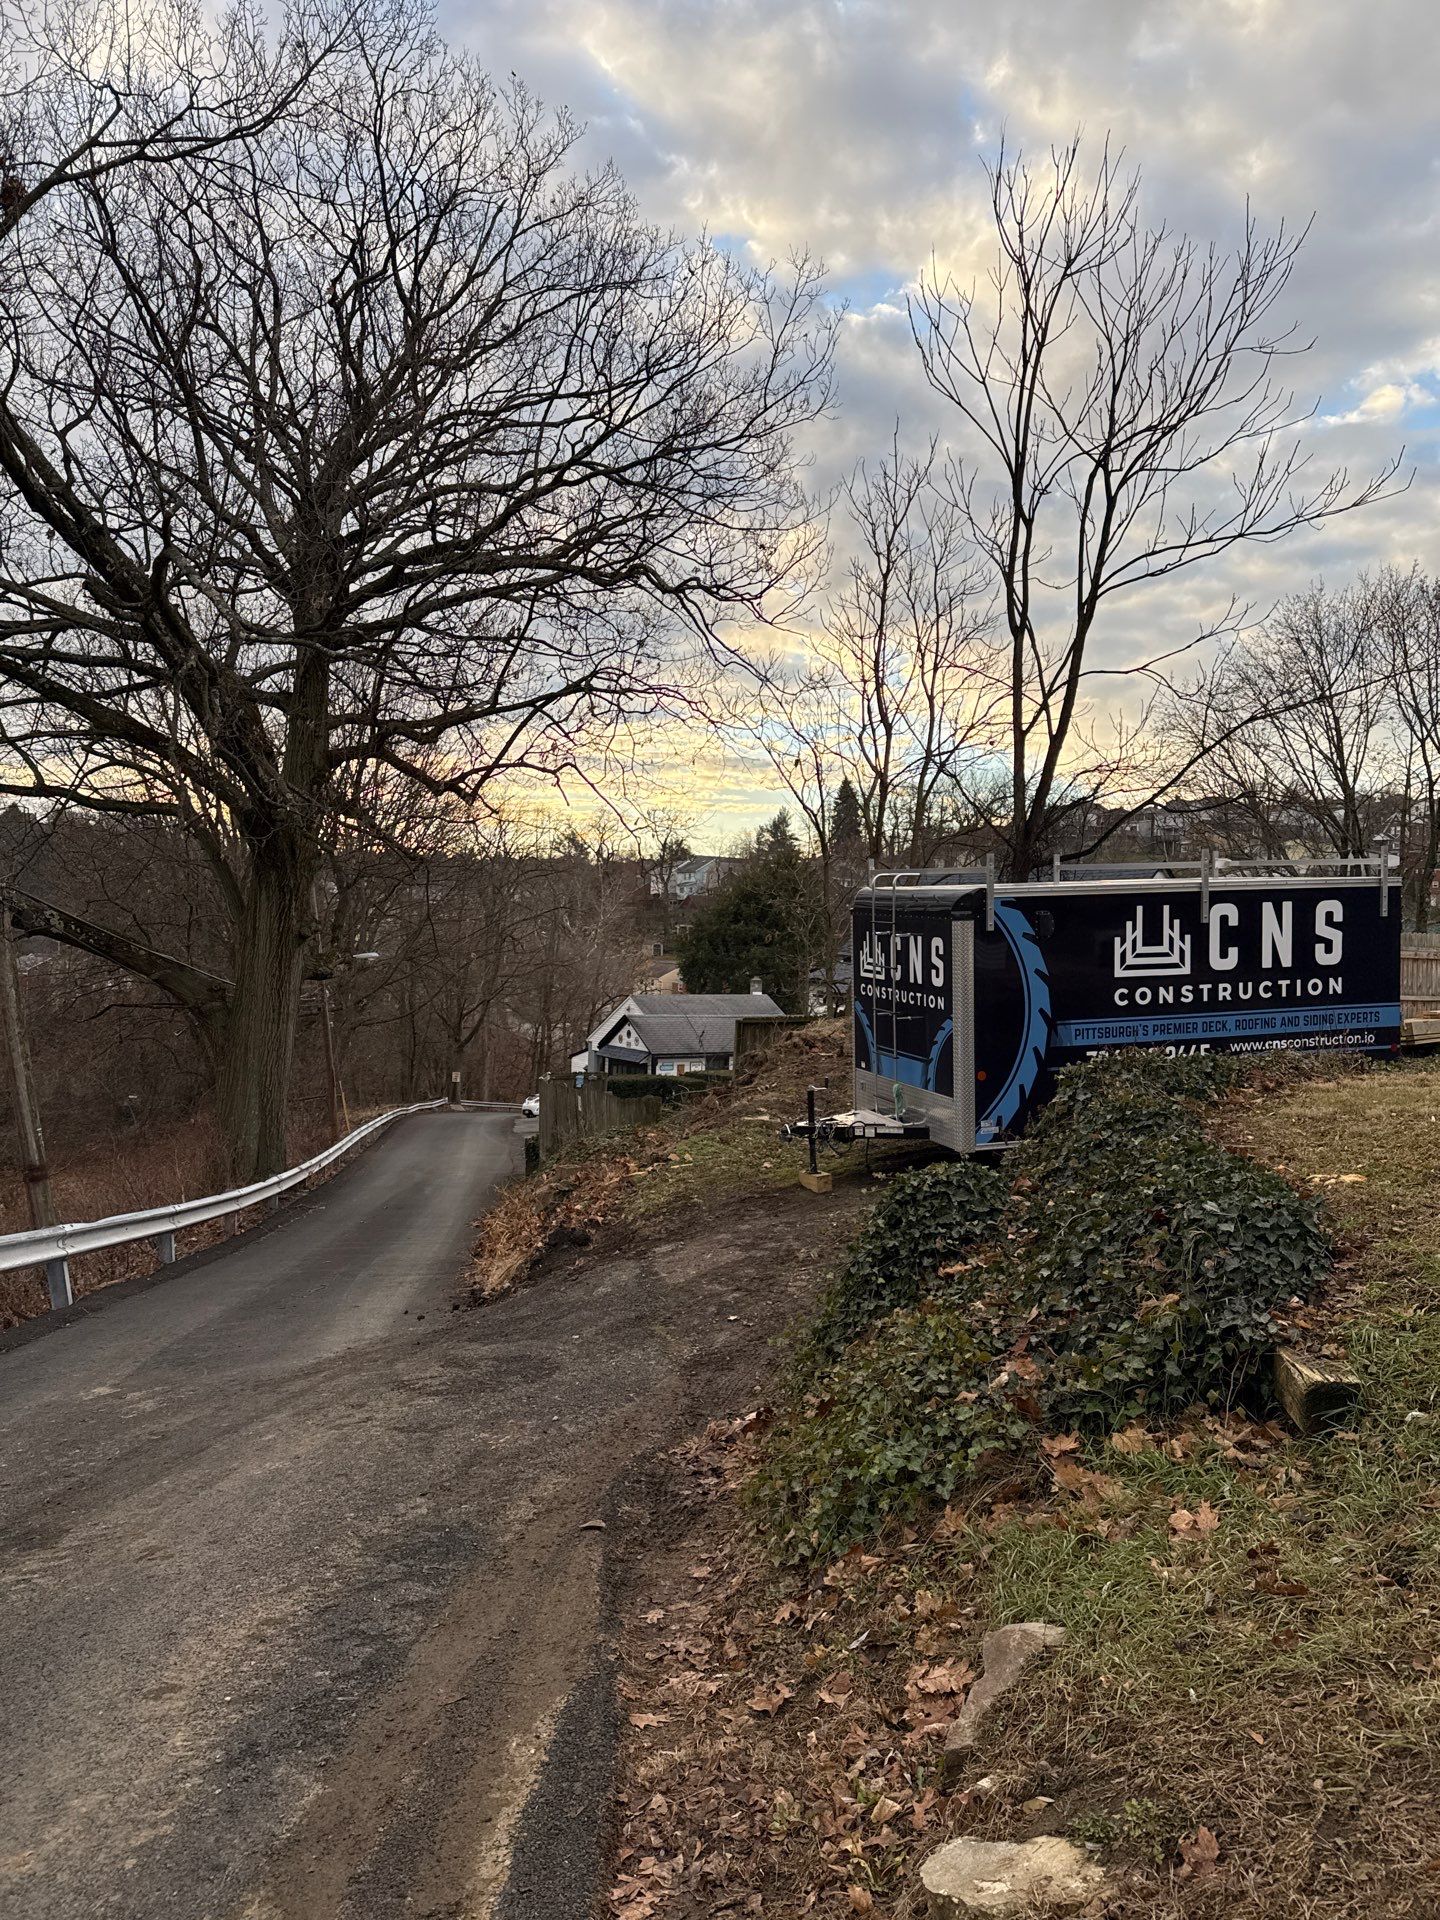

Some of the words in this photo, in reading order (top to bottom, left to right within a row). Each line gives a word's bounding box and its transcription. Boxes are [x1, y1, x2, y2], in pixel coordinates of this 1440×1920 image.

[1209, 899, 1344, 971] CNS
[890, 935, 944, 988] CNS
[1114, 976, 1343, 1007] CONSTRUCTION
[1074, 1023, 1149, 1041] PITTSBURGH'S
[1152, 1021, 1198, 1036] PREMIER
[1201, 1019, 1232, 1034] DECK,
[1234, 1017, 1277, 1031] ROOFING
[1280, 1015, 1300, 1028] AND
[1303, 1013, 1334, 1027] SIDING
[1337, 1011, 1380, 1024] EXPERTS
